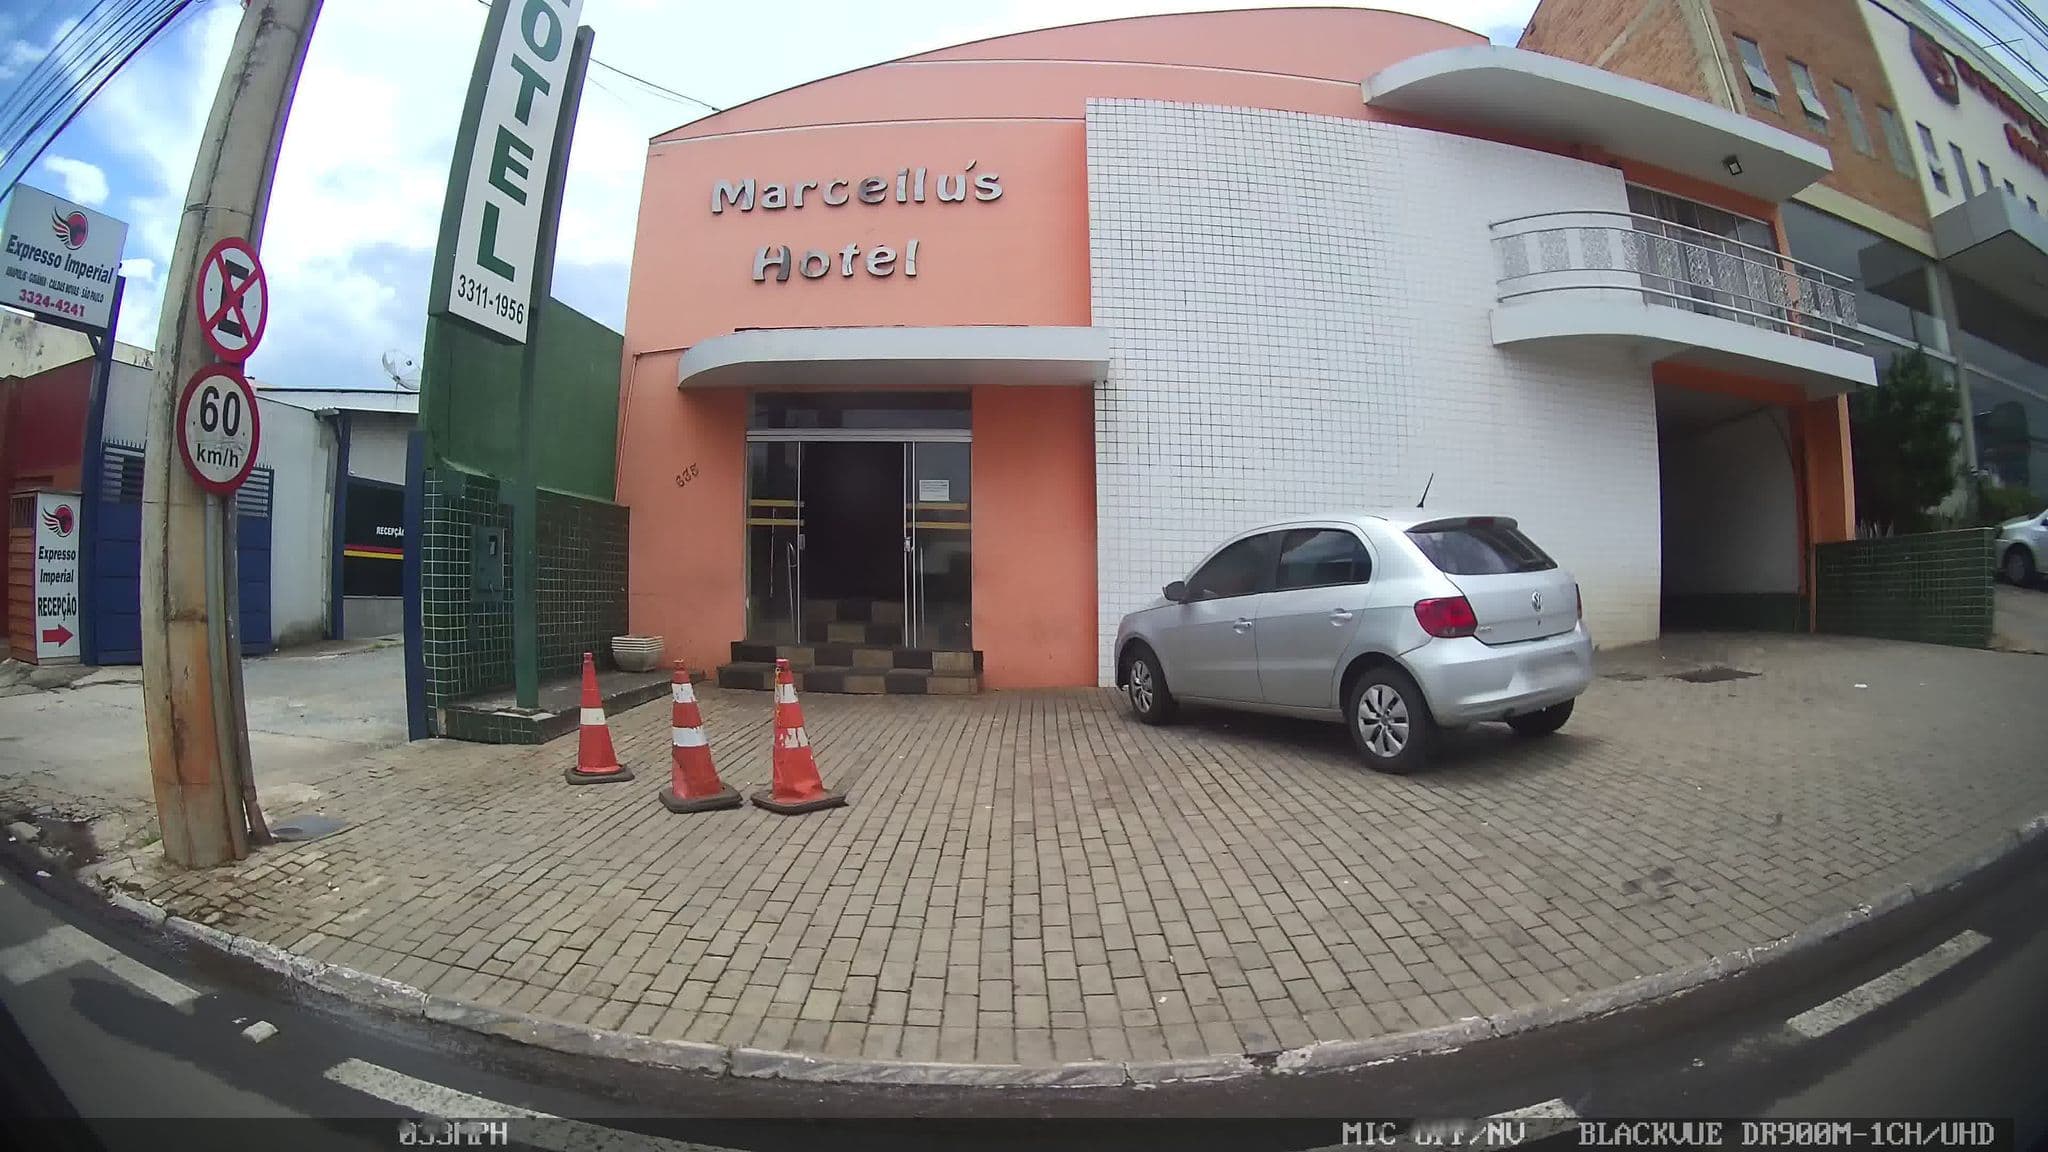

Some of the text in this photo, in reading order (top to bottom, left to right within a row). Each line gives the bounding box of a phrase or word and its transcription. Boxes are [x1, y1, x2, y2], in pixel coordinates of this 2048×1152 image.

[477, 0, 563, 282] OTEL
[6, 234, 114, 284] Expresso Imperial
[751, 240, 920, 283] Hotel
[19, 289, 85, 317] 3324-4241
[457, 274, 524, 324] 3311-1956
[199, 385, 241, 437] 60
[196, 443, 239, 470] km/h
[38, 546, 76, 562] Expresso
[39, 568, 74, 585] Imperial
[38, 593, 77, 620] RECEPÇÃO
